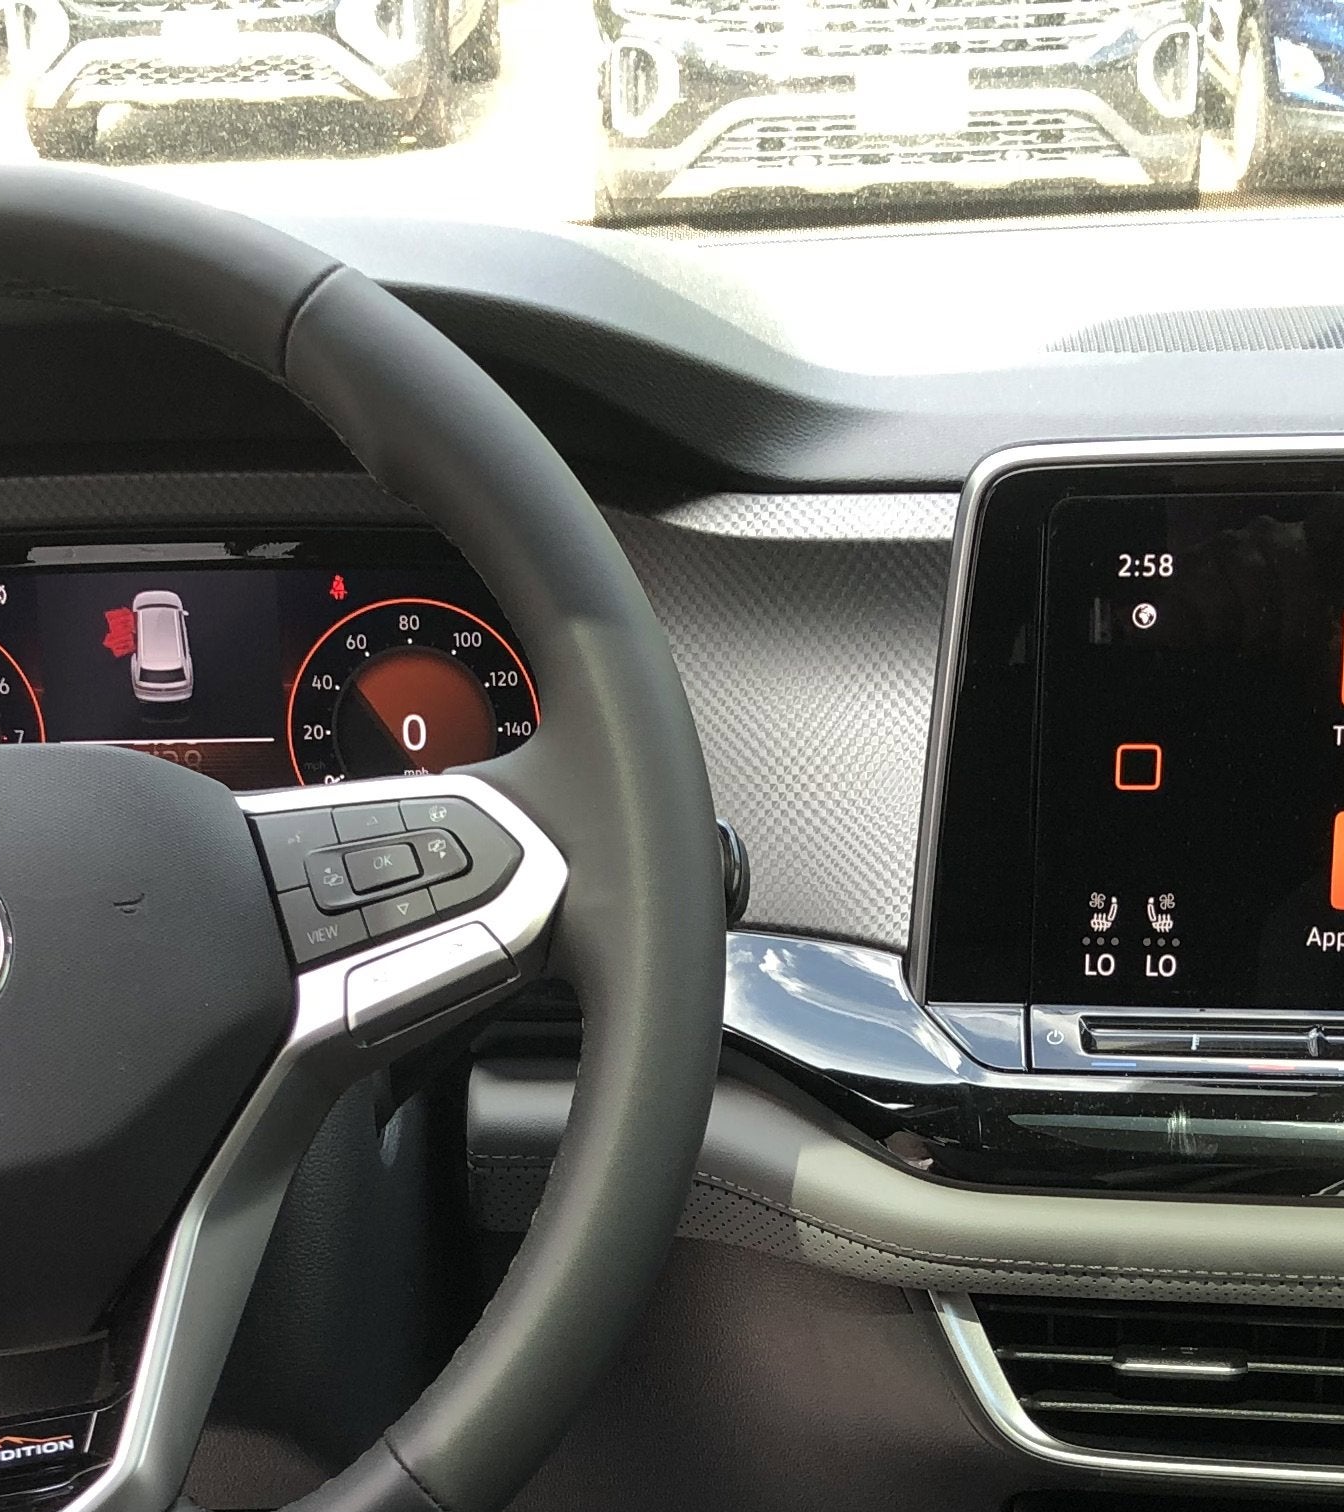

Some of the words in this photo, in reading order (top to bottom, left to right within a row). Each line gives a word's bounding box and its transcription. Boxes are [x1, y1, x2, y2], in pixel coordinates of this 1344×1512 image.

[1117, 553, 1174, 577] 2:58
[399, 615, 420, 630] 80
[346, 634, 367, 650] 60
[453, 631, 482, 648] 100
[0, 677, 10, 694] 6
[311, 674, 333, 690] 40
[489, 670, 518, 687] 120
[303, 725, 324, 740] 20
[402, 714, 427, 751] 0
[505, 721, 532, 736] 140
[14, 730, 24, 744] 7
[373, 854, 394, 870] OK
[306, 924, 339, 945] VIEW
[1084, 954, 1115, 977] LO
[1145, 955, 1176, 978] LO
